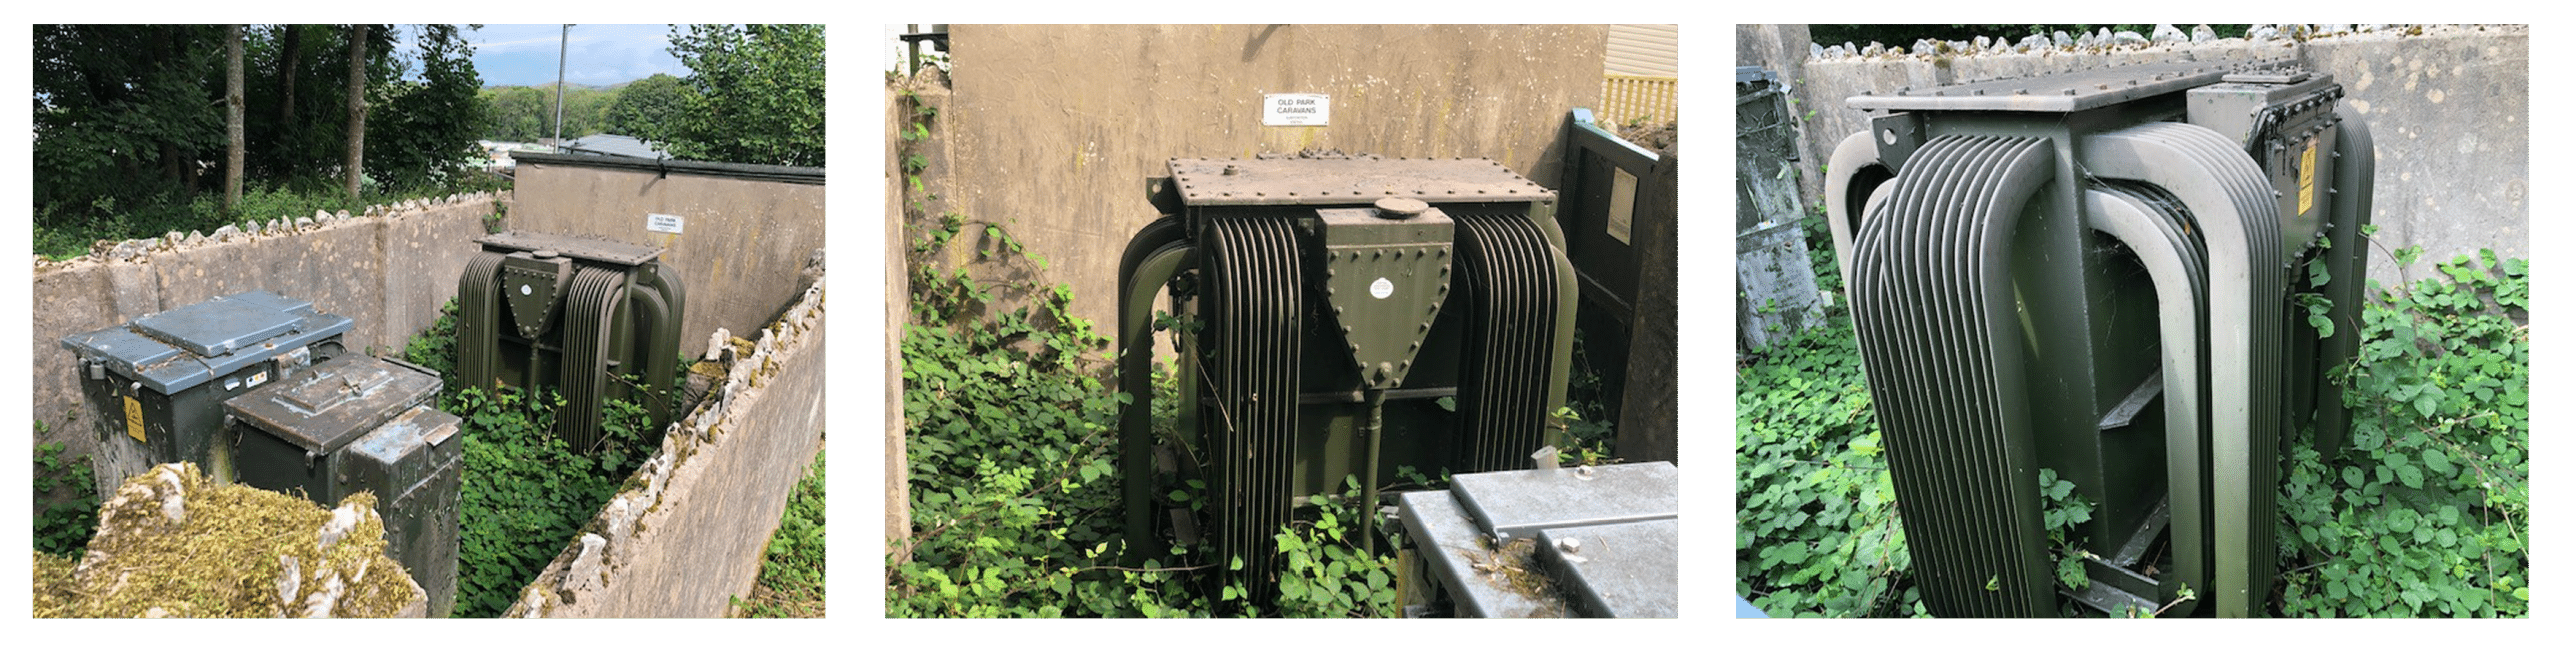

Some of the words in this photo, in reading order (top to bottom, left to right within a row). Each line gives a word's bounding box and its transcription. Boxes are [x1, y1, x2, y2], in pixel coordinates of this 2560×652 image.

[1277, 98, 1294, 106] OLD
[1296, 98, 1316, 106] PARK
[1276, 106, 1317, 114] CARAVANS
